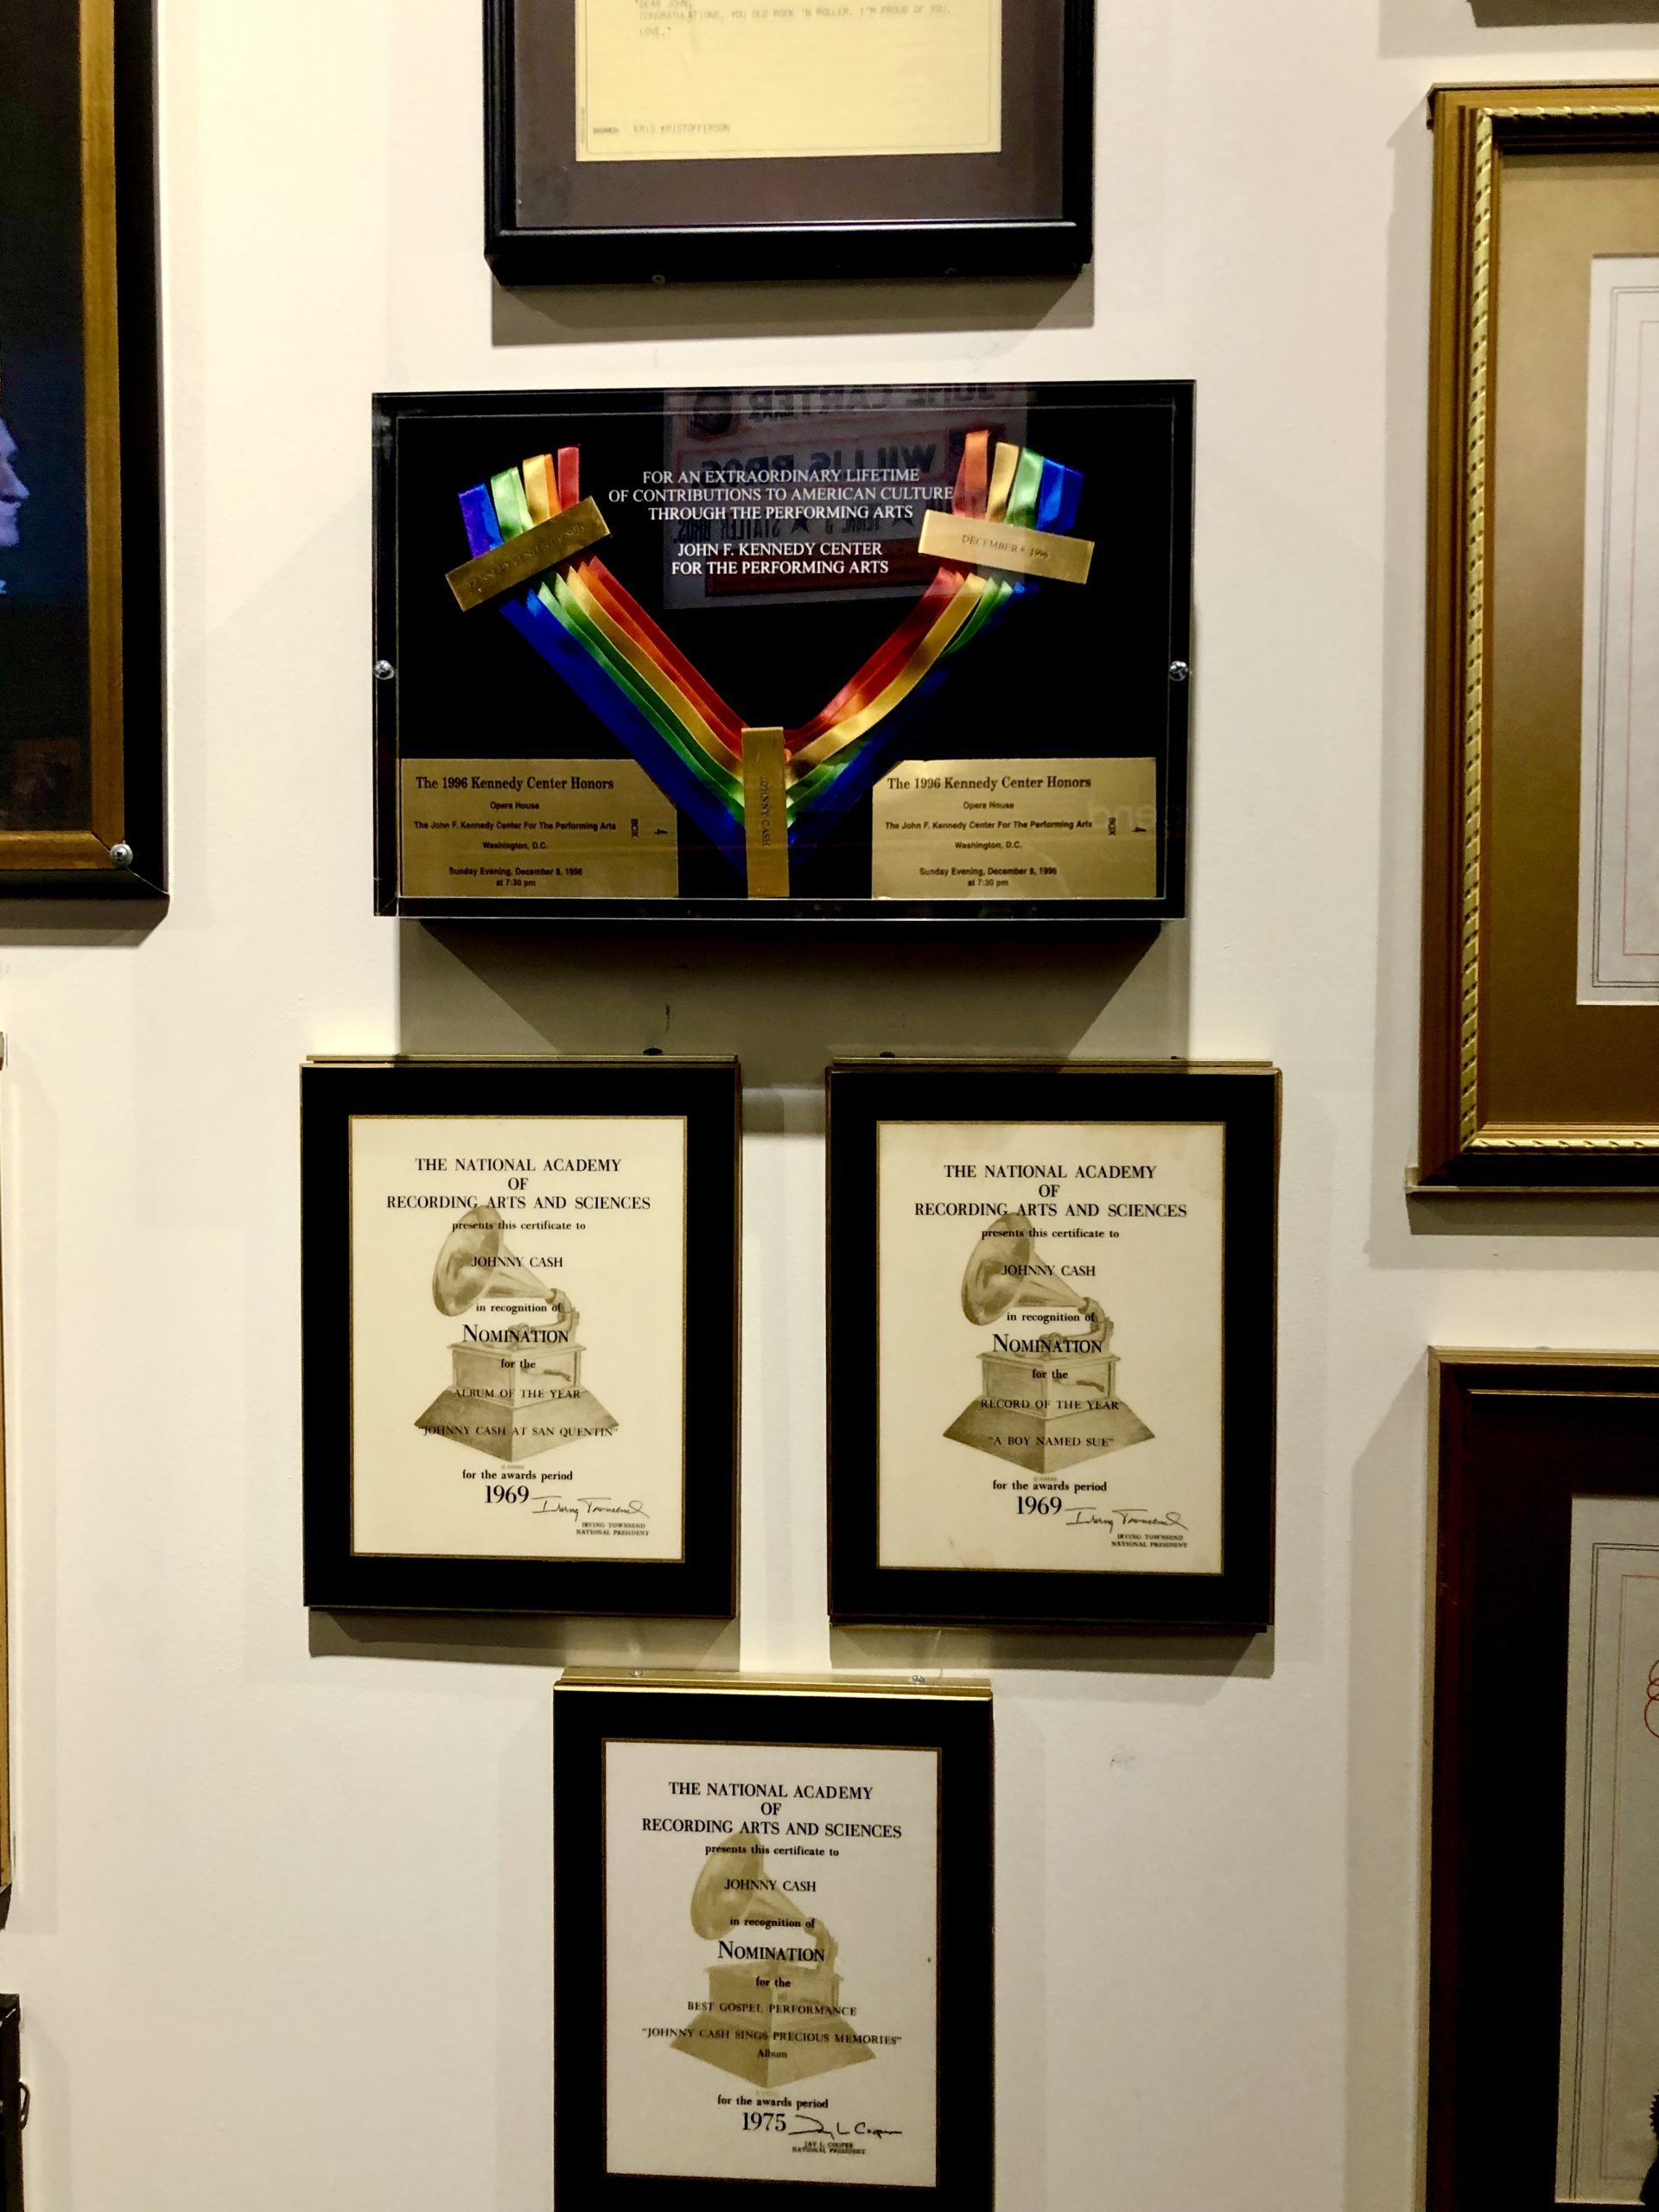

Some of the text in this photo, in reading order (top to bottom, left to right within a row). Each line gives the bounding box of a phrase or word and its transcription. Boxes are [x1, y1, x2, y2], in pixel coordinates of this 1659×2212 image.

[643, 468, 919, 483] FOR AN EXTRAORDINARY LIFETIME
[608, 486, 954, 502] OF CONTRIBUTIONS TO AMERICAN CULTURE
[648, 505, 913, 520] THROUGH THE PERFORMING ARTS
[677, 543, 883, 556] JOHN F. KENNEDY CENTER
[962, 534, 1018, 553] DECEMBER
[671, 561, 889, 575] FOR THE PERFORMING ARTS
[416, 776, 613, 791] The 1996 Kennedy Center Honors
[887, 776, 1091, 791] The 1996 Kennedy Center Honors
[490, 801, 512, 810] Opera
[461, 822, 494, 830] Kennedy
[497, 822, 522, 830] Center
[556, 823, 598, 831] Performing
[762, 819, 771, 847] CASH
[955, 842, 1003, 850] Washington,
[919, 868, 949, 877] Sunday
[951, 868, 985, 876] Evening,
[415, 1158, 621, 1172] THE NATIONAL ACADEMY
[944, 1165, 1156, 1179] THE NATIONAL ACADEMY
[508, 1177, 529, 1191] OF
[1039, 1184, 1060, 1198] OF
[387, 1196, 651, 1210] RECORDING ARTS AND SCIENCES
[914, 1203, 1187, 1217] RECORDING ARTS AND SCIENCES
[452, 1222, 493, 1232] presents
[498, 1220, 517, 1230] this
[520, 1221, 571, 1230] certificate
[471, 1256, 563, 1268] JOHNNY CASH
[1001, 1264, 1096, 1276] JOHNNY CASH
[476, 1303, 562, 1314] in recognition of
[500, 1358, 536, 1369] for the
[454, 1389, 581, 1399] ALBUM OF THE YEAR
[981, 1399, 1120, 1410] RECORD OF THE YEAR
[476, 1426, 505, 1435] CASH
[512, 1427, 527, 1436] AT
[532, 1427, 554, 1436] SAN
[1007, 1437, 1030, 1446] BOY
[1036, 1437, 1081, 1446] NAMED
[462, 1469, 573, 1483] for the awards period
[485, 1484, 530, 1503] 1969
[1016, 1496, 1063, 1515] 1969
[669, 1781, 873, 1800] THE NATIONAL ACADEMY
[760, 1802, 782, 1815] OF
[642, 1818, 902, 1839] RECORDING ARTS AND SCIENCES
[724, 1878, 817, 1892] JOHNNY CASH
[687, 2001, 857, 2016] BEST GOSPEL PERFORMANCE
[699, 2029, 730, 2039] CASH
[734, 2030, 768, 2040] SINGS
[772, 2031, 830, 2043] PRECIOUS
[757, 2049, 787, 2059] Album
[742, 2112, 786, 2132] 1975
